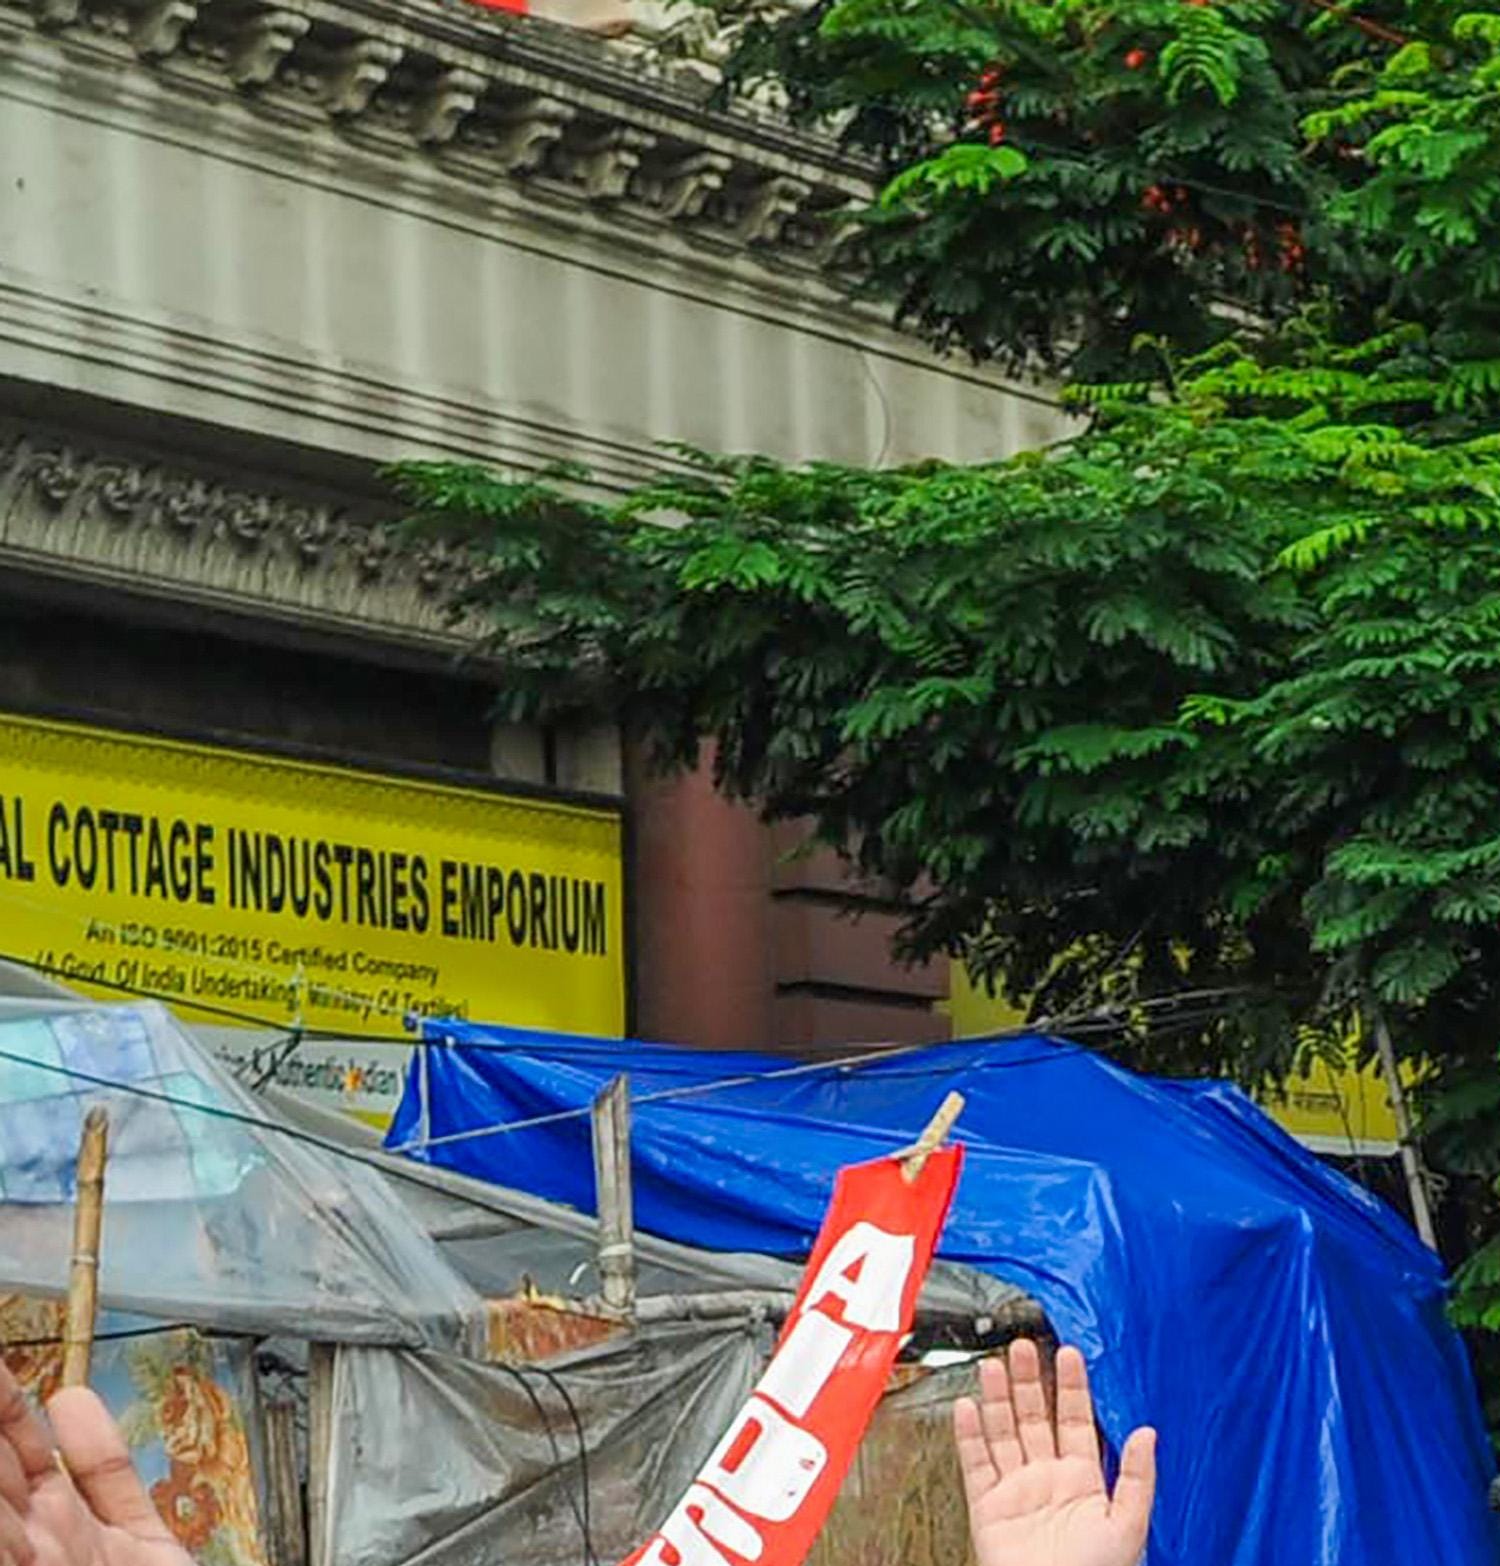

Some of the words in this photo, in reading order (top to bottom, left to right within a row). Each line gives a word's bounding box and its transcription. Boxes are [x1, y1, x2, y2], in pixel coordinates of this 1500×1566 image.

[48, 801, 215, 906] COTTAGE
[228, 827, 430, 934] INDUSTRIES
[441, 860, 608, 957] EMPORIUM
[353, 952, 439, 987] Company
